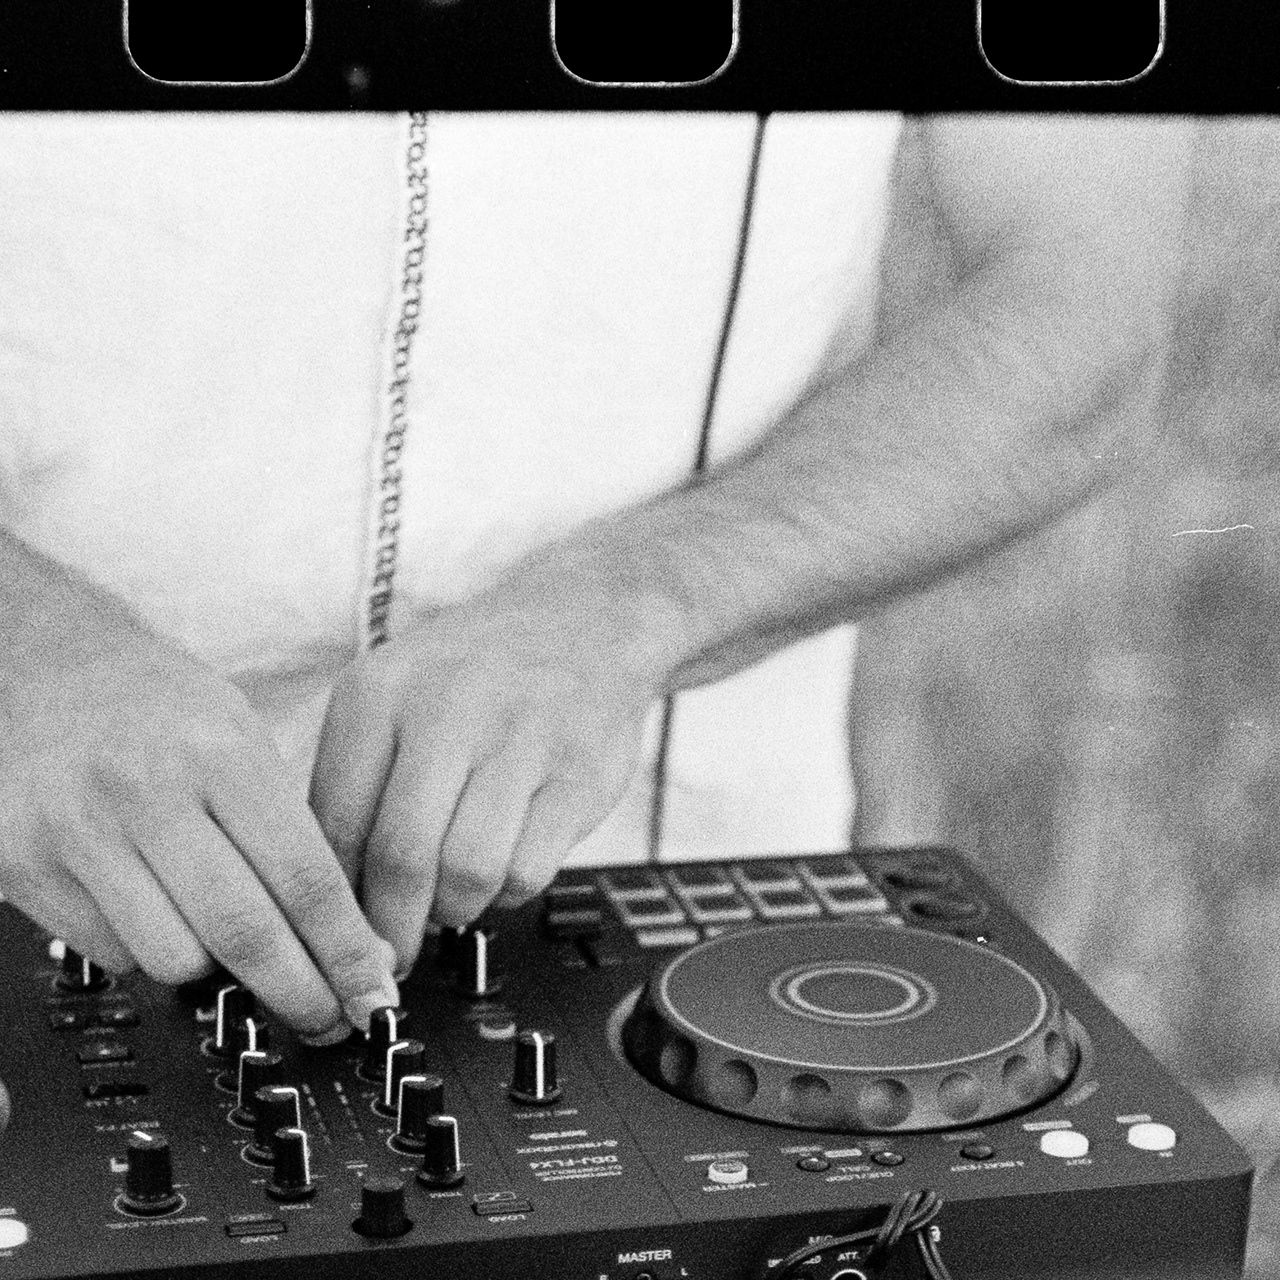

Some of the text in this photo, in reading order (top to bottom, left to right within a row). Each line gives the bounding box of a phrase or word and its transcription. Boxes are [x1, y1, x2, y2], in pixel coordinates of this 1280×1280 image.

[529, 1155, 619, 1170] DDJ-FLX4
[618, 1249, 673, 1264] MASTER
[680, 1267, 689, 1277] L
